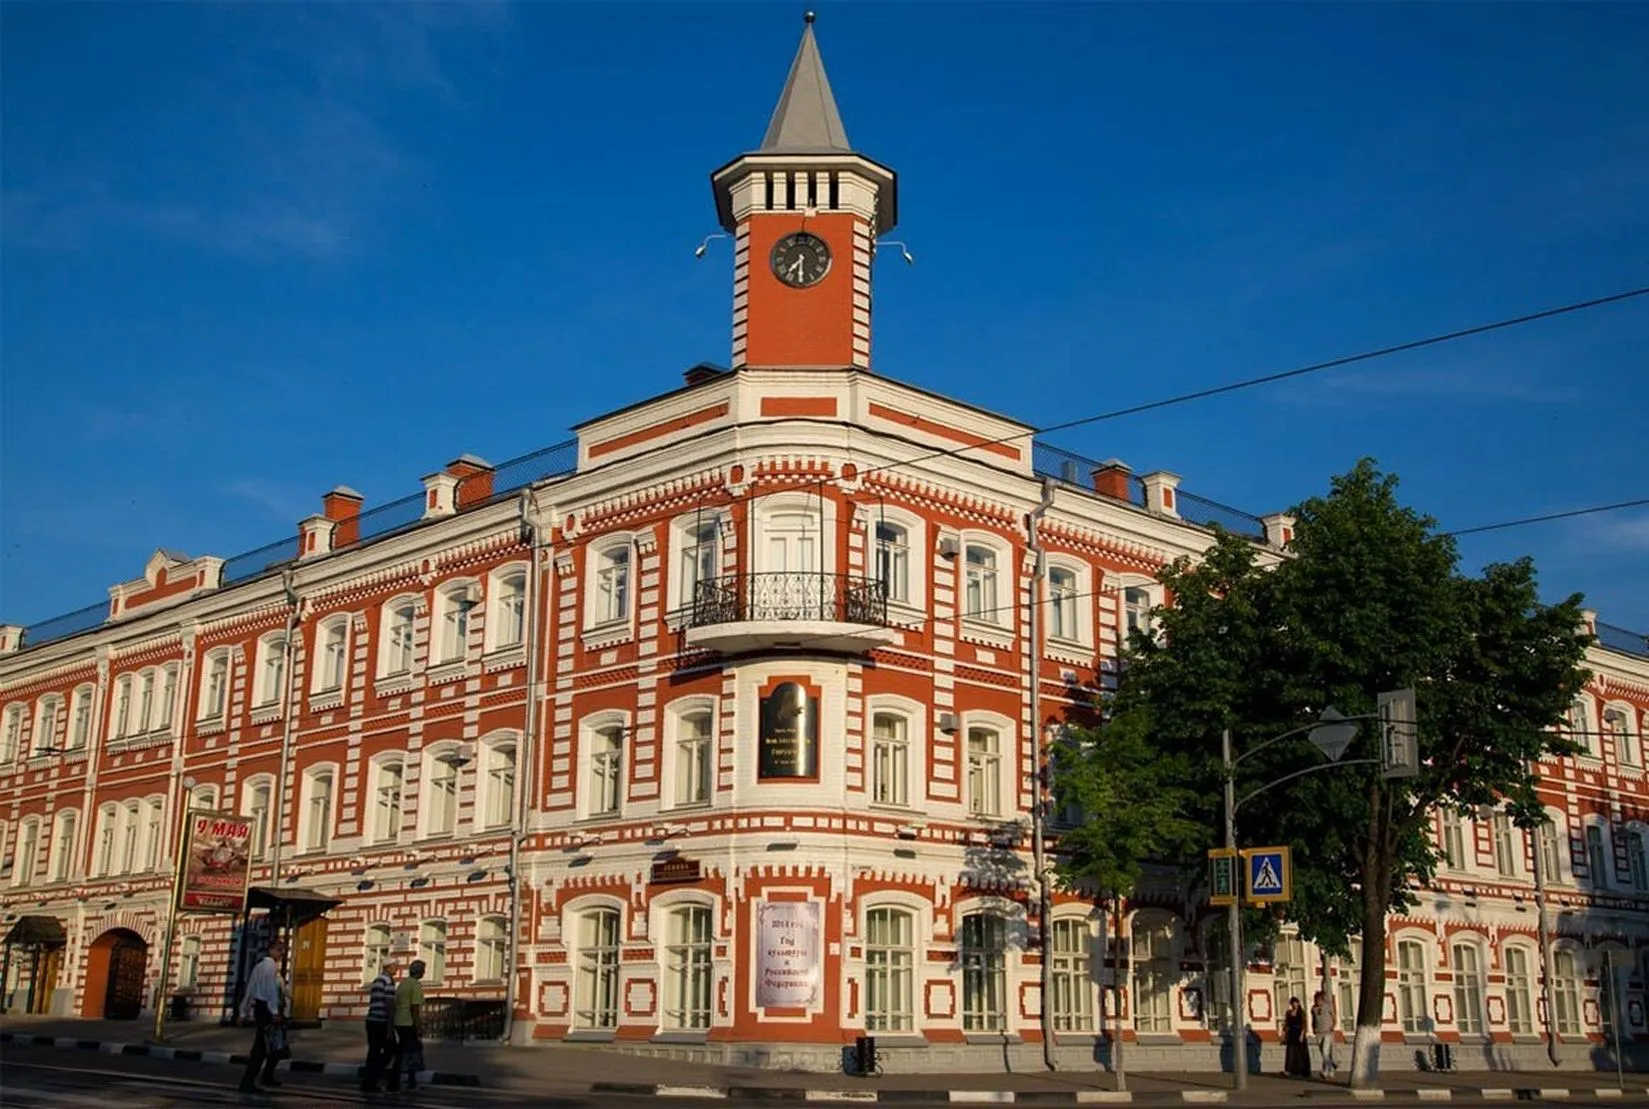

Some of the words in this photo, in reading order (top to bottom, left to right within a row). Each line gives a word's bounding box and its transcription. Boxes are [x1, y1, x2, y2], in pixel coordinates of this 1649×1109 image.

[197, 820, 207, 833] 9
[213, 822, 248, 838] МАЯ
[780, 936, 795, 946] Год
